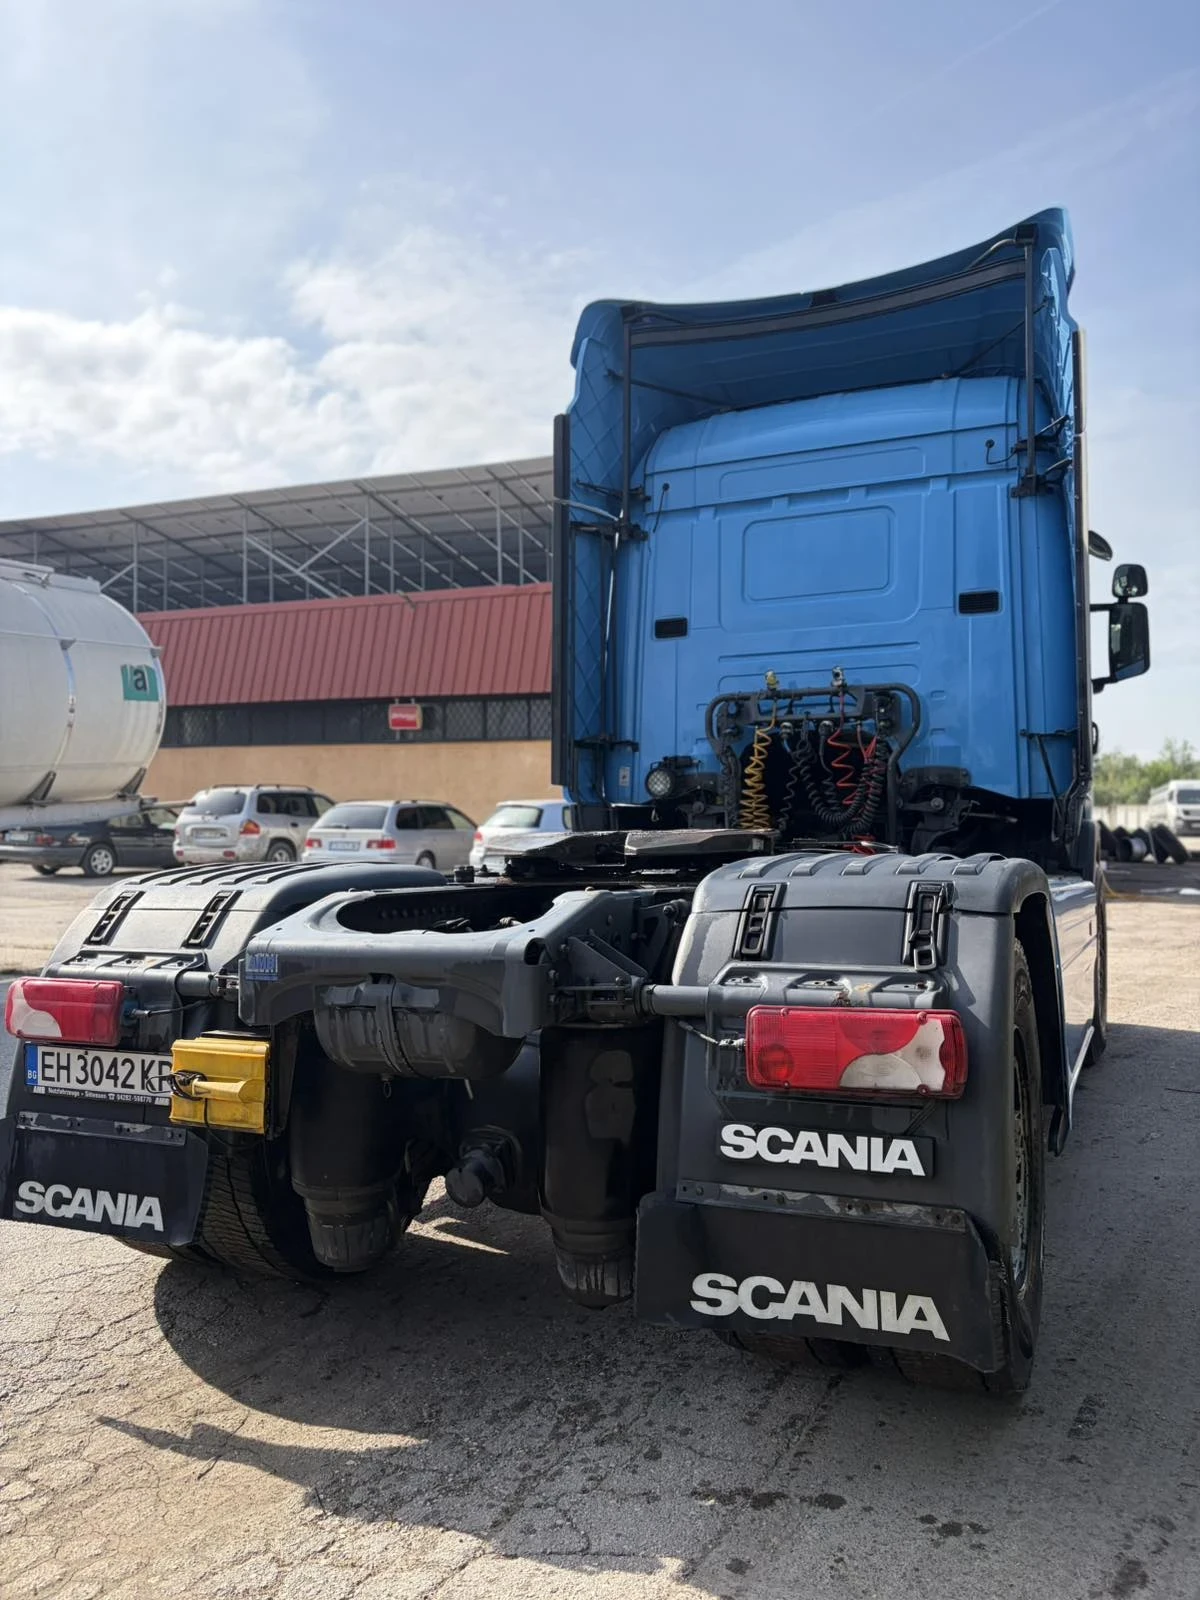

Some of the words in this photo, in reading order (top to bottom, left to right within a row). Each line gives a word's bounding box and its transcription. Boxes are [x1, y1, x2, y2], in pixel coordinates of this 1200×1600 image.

[27, 1070, 37, 1080] BG
[720, 1123, 926, 1177] SCANIA
[14, 1180, 164, 1232] SCANIA
[690, 1272, 951, 1342] SCANIA
